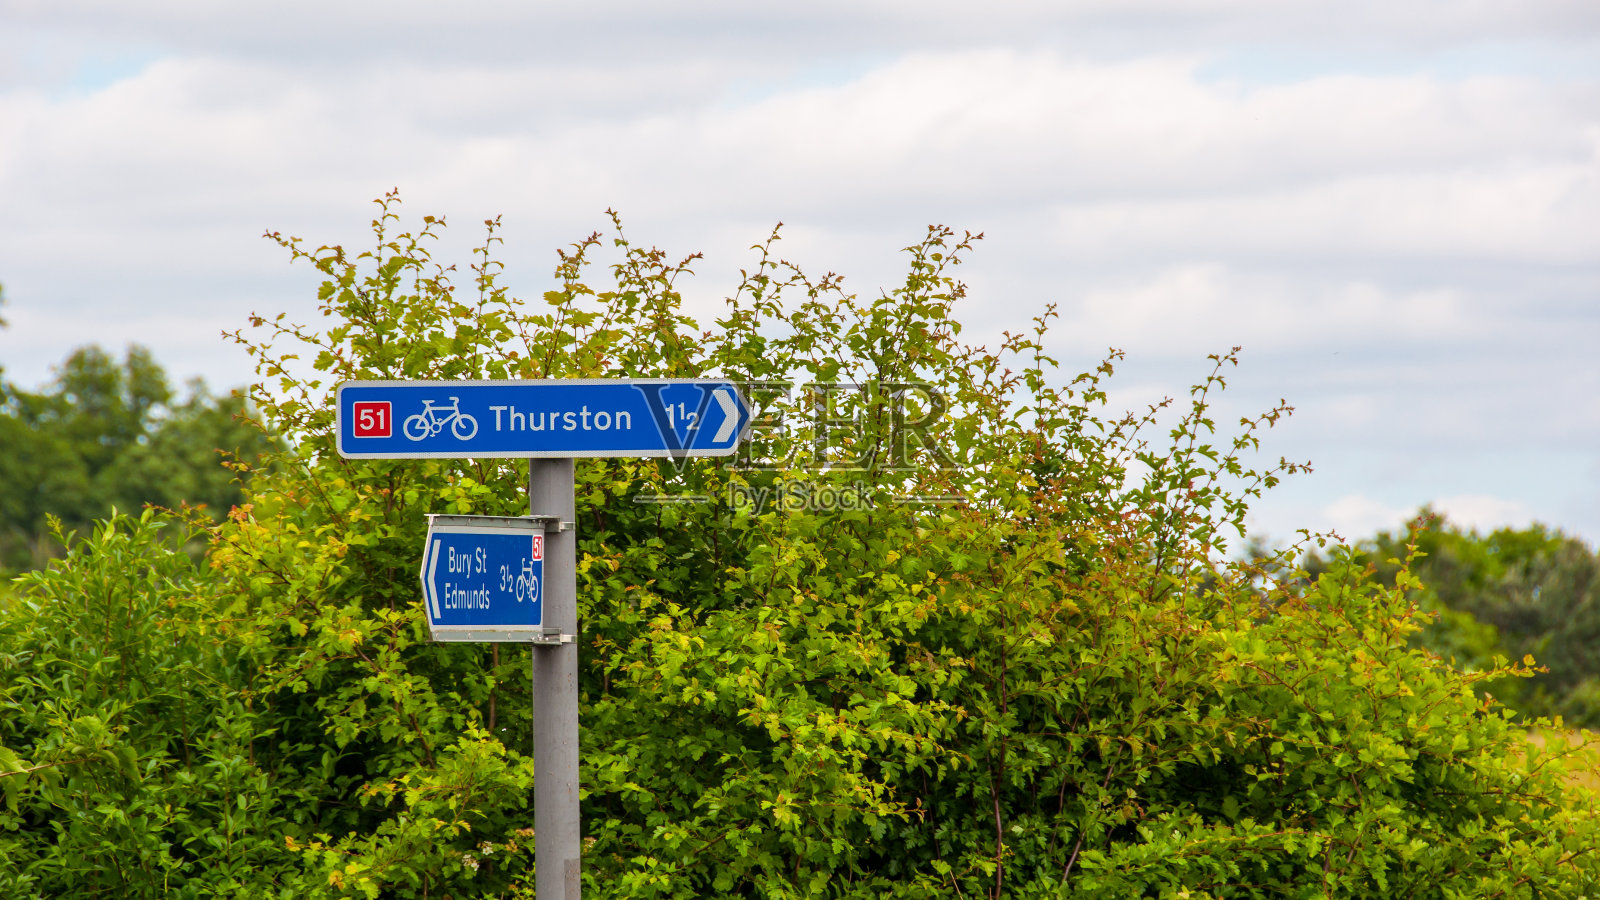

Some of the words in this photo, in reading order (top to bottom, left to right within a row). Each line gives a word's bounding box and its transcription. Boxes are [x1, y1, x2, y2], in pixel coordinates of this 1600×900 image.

[359, 409, 384, 430] 51
[490, 405, 631, 431] Thurston
[533, 537, 542, 557] 51
[448, 546, 472, 579] Bury
[475, 547, 487, 573] St
[445, 583, 490, 610] Edmunds
